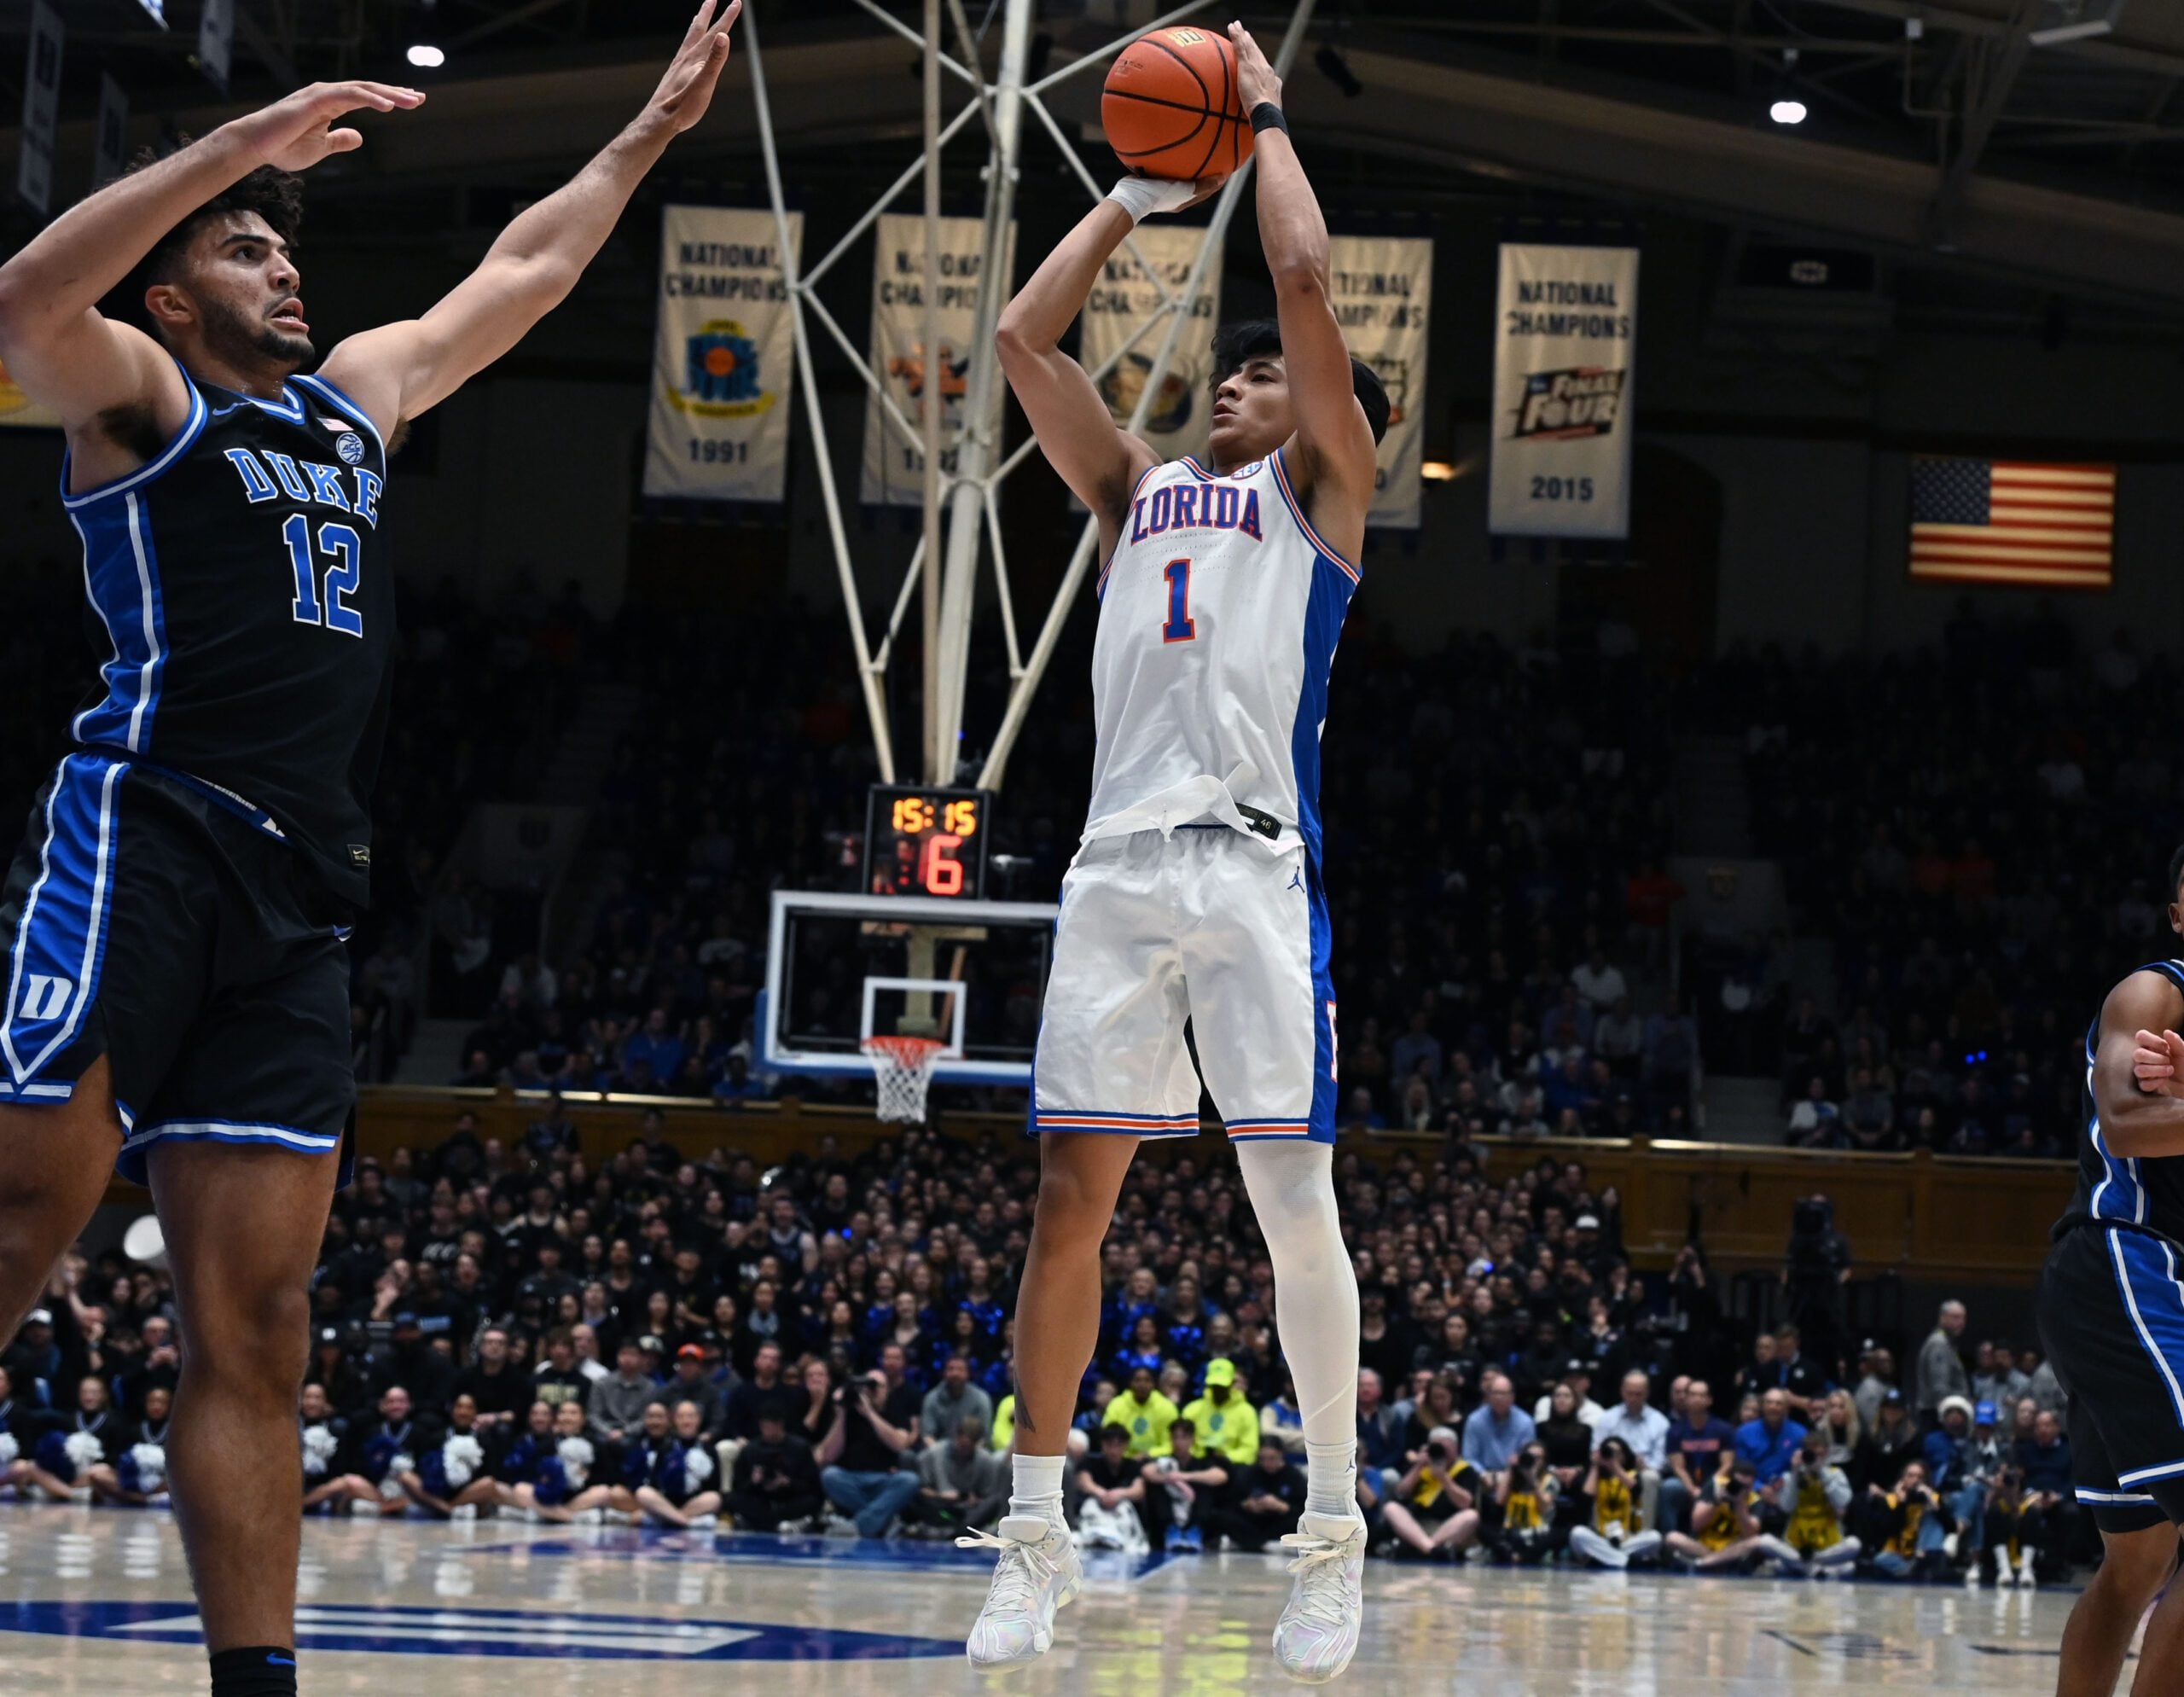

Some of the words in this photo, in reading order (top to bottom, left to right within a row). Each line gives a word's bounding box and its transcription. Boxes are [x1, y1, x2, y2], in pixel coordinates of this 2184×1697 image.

[1519, 281, 1617, 307] NATIONAL
[1508, 311, 1630, 339] CHAMPIONS
[342, 443, 360, 452] ACC
[689, 439, 747, 463] 1991
[224, 448, 383, 531] DUKE
[1531, 476, 1594, 502] 2015
[1130, 484, 1263, 546] LORIDA
[282, 513, 363, 639] 12
[1163, 558, 1196, 643] 1
[892, 797, 976, 837] 15:15
[1260, 819, 1272, 829] 46
[926, 834, 963, 895] 6
[18, 973, 73, 1020] D
